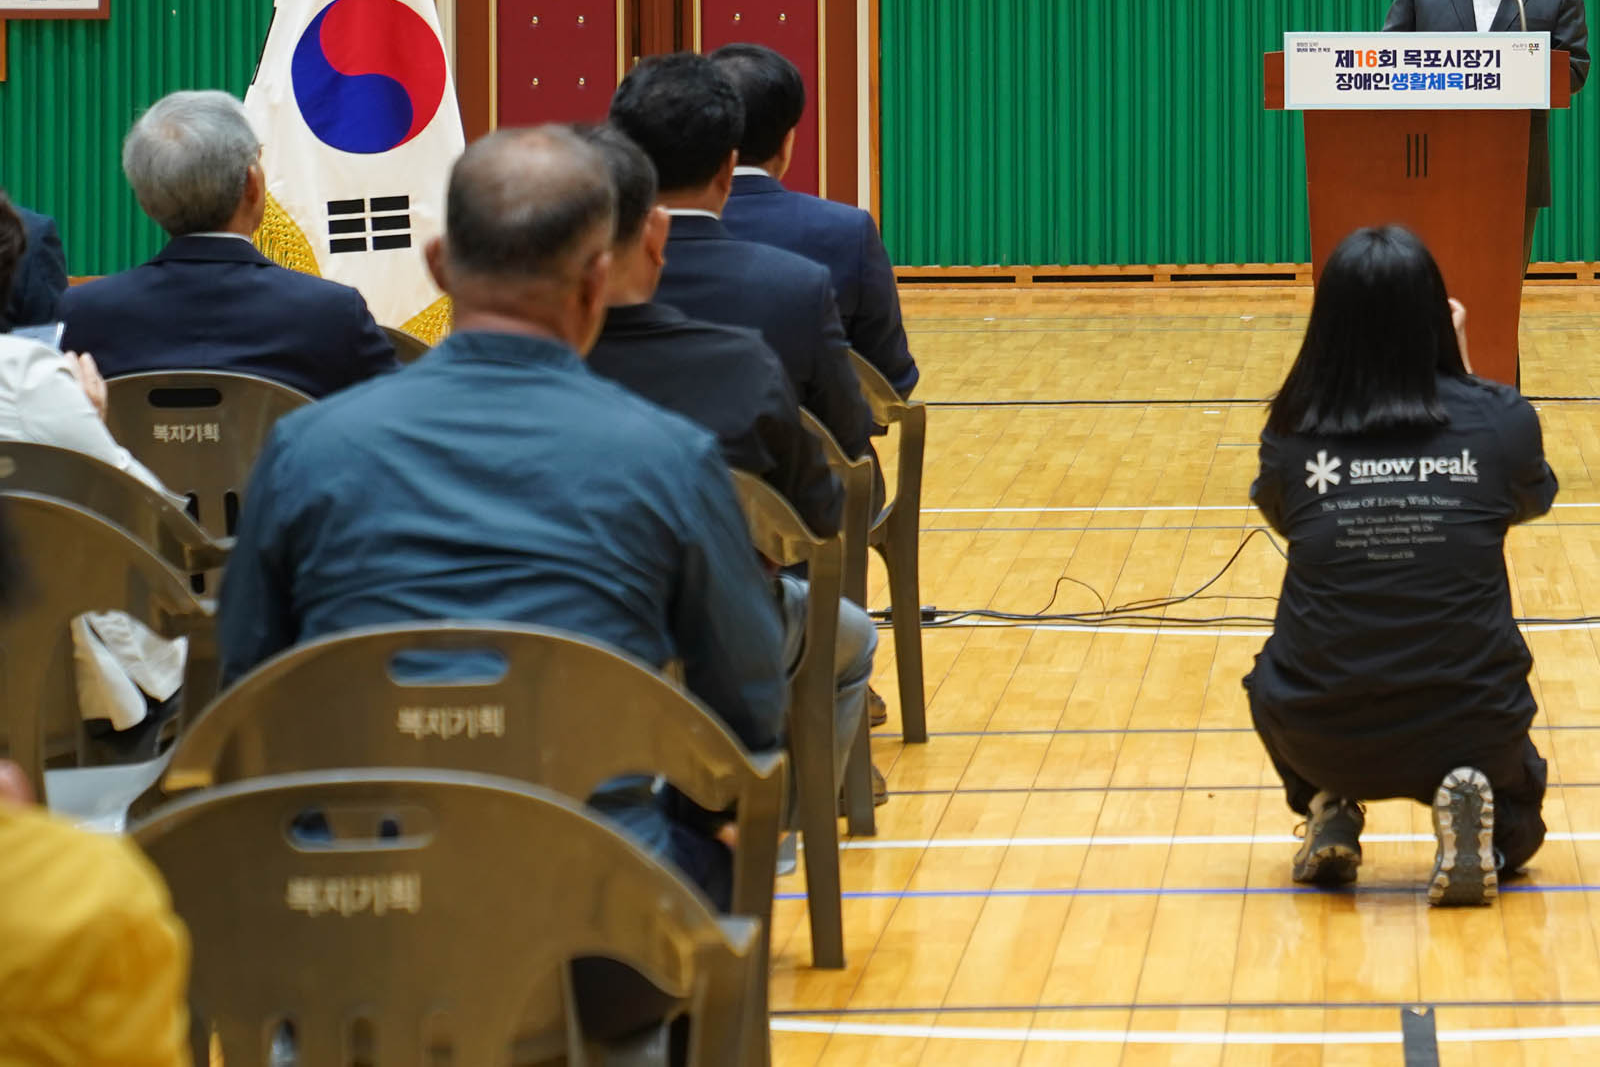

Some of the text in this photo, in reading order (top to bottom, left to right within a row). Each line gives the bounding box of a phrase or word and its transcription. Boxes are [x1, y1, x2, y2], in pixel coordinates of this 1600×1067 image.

[1335, 49, 1501, 69] 제16회 목포시장기
[1335, 72, 1501, 91] 장애인생활체육대회
[152, 424, 219, 443] 복지기획
[1350, 449, 1478, 482] snow peak
